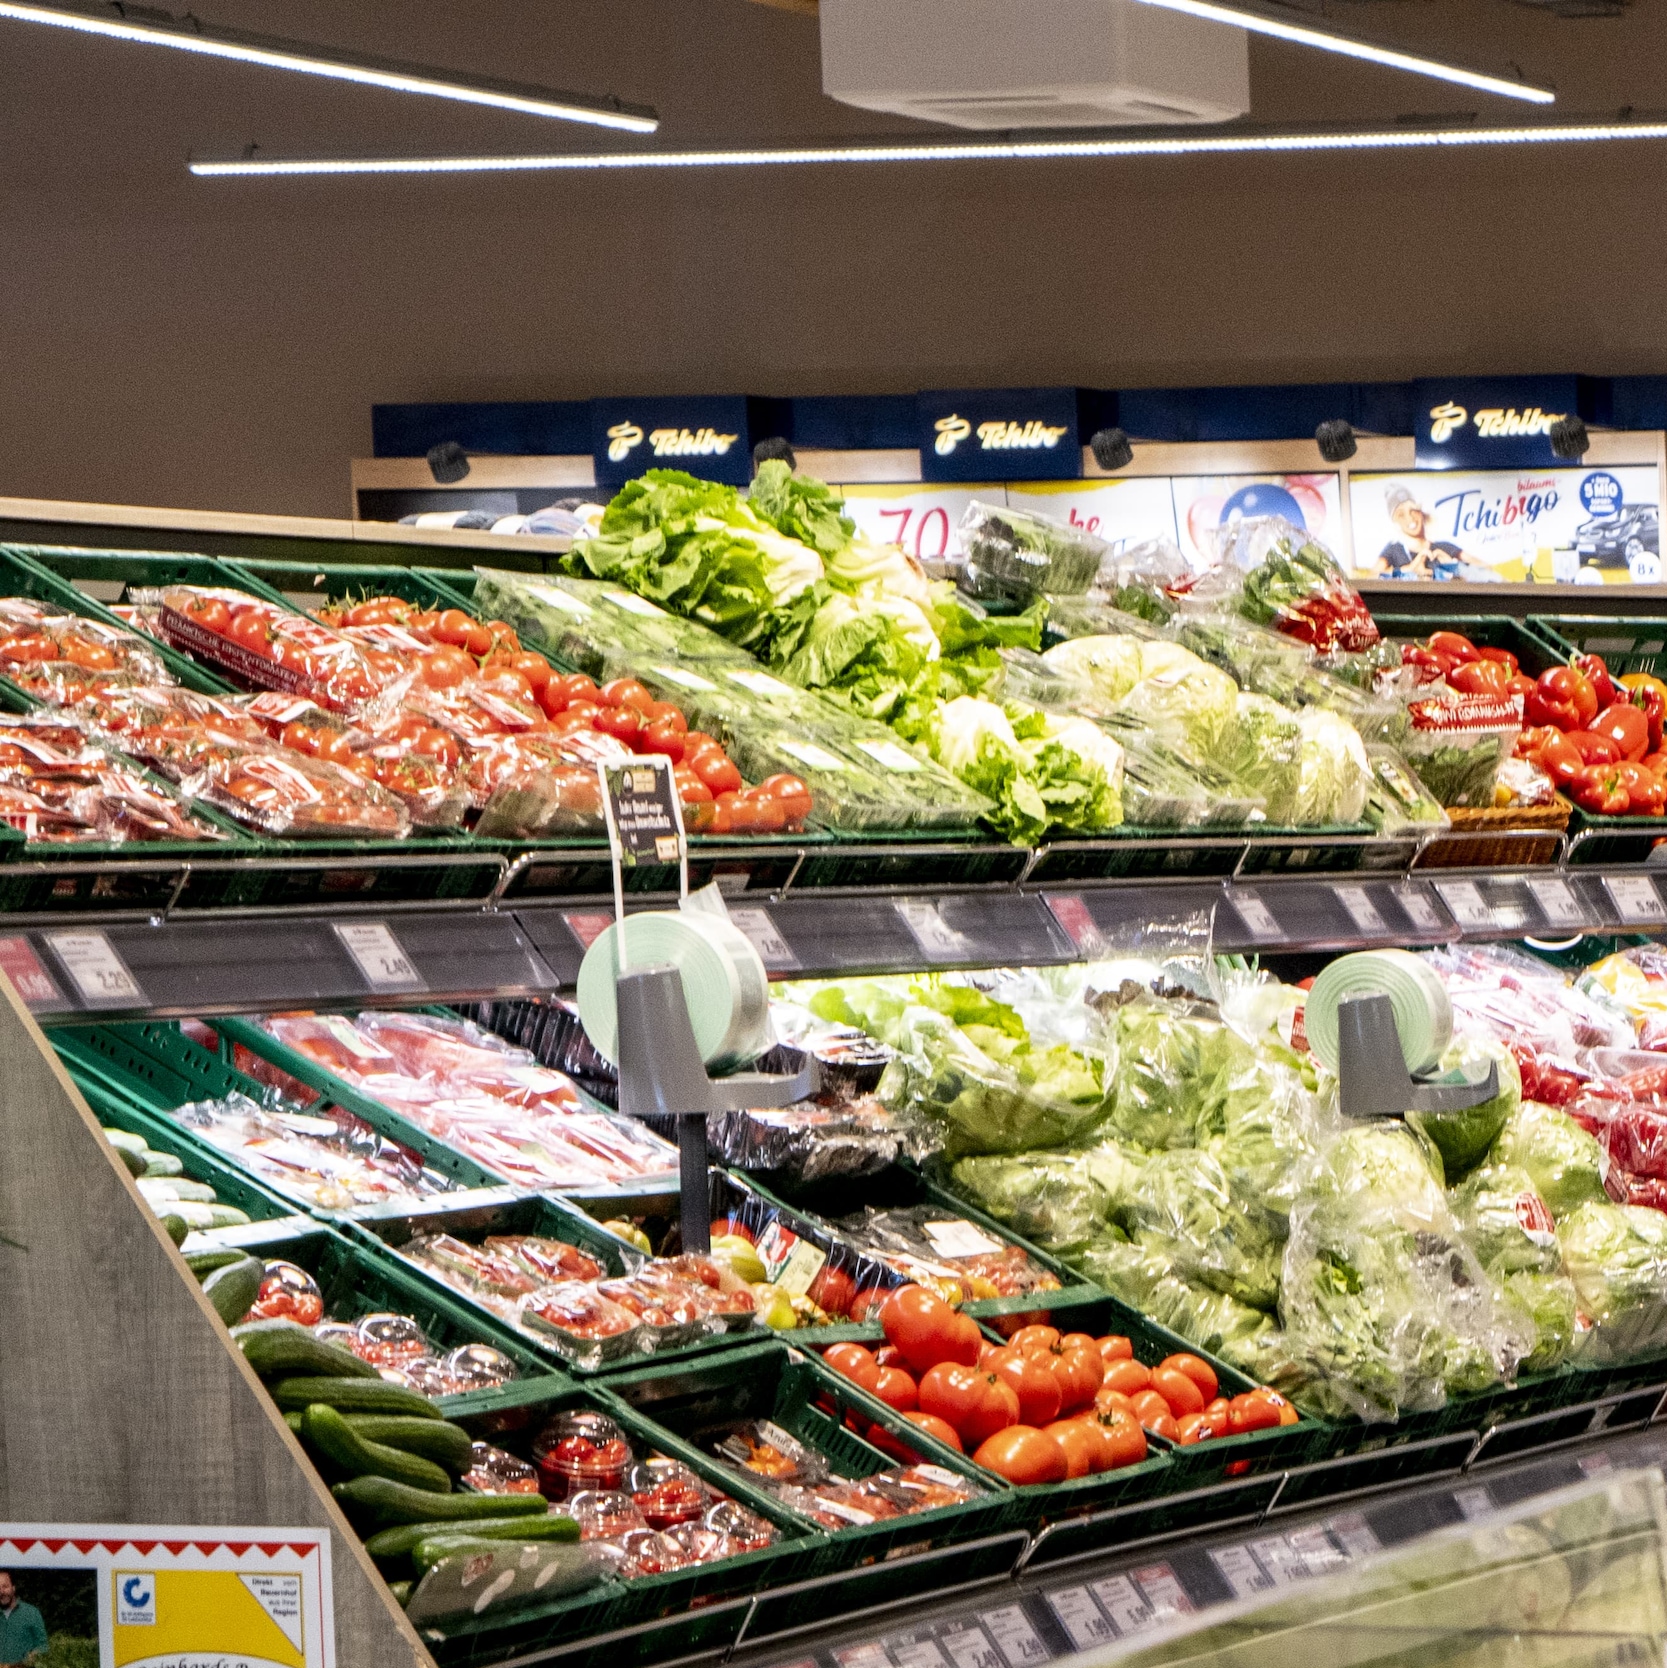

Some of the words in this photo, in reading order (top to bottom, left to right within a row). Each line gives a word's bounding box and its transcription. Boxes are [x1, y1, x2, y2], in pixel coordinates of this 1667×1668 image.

[977, 420, 1065, 448] Tchibo
[1473, 407, 1567, 437] Tchibo
[650, 429, 739, 456] Tchibo
